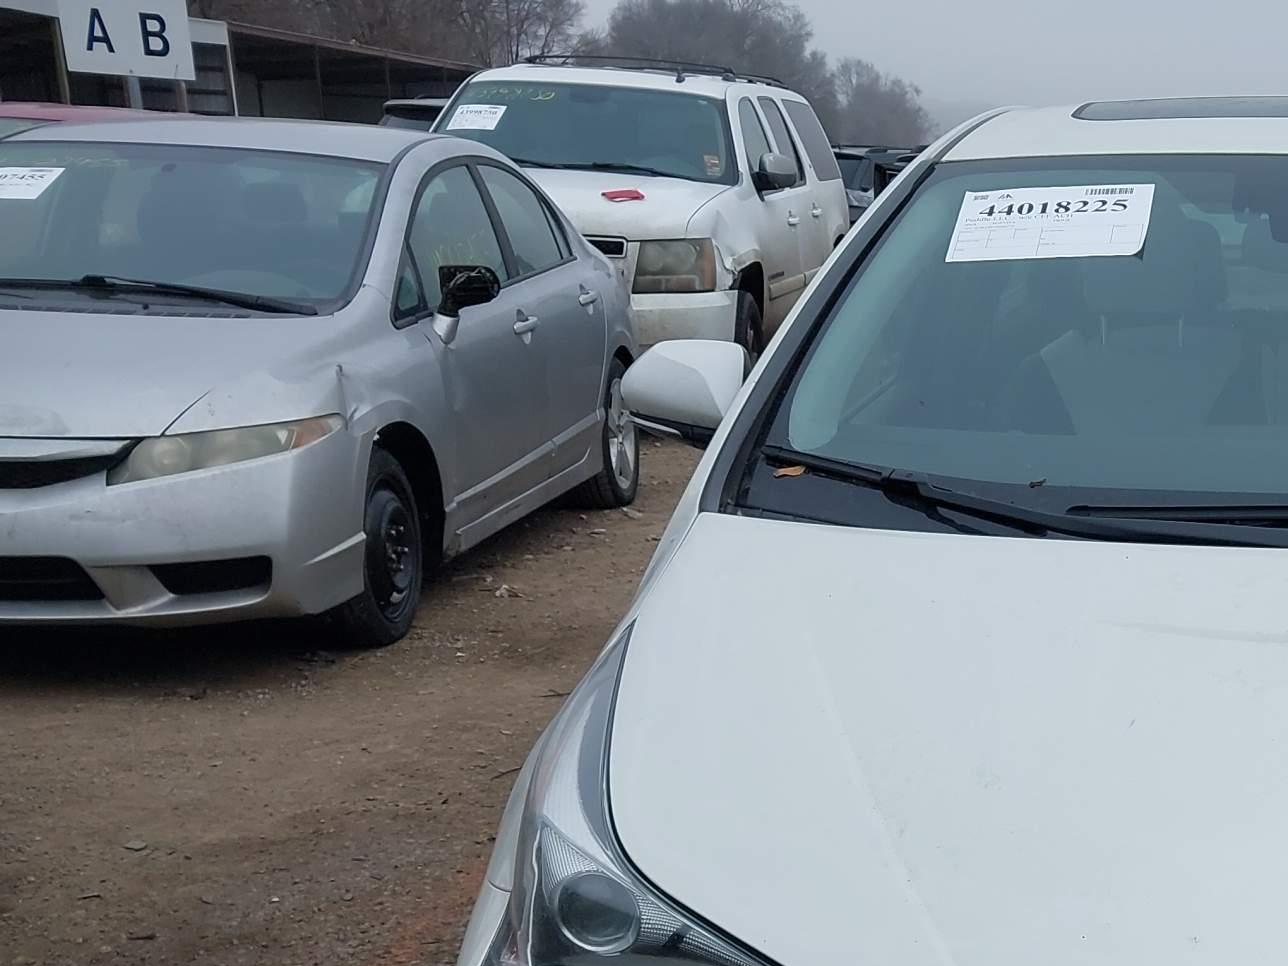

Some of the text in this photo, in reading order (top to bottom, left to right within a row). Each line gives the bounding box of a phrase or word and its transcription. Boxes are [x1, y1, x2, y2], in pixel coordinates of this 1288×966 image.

[86, 8, 171, 58] A B
[978, 199, 1129, 217] 44018225
